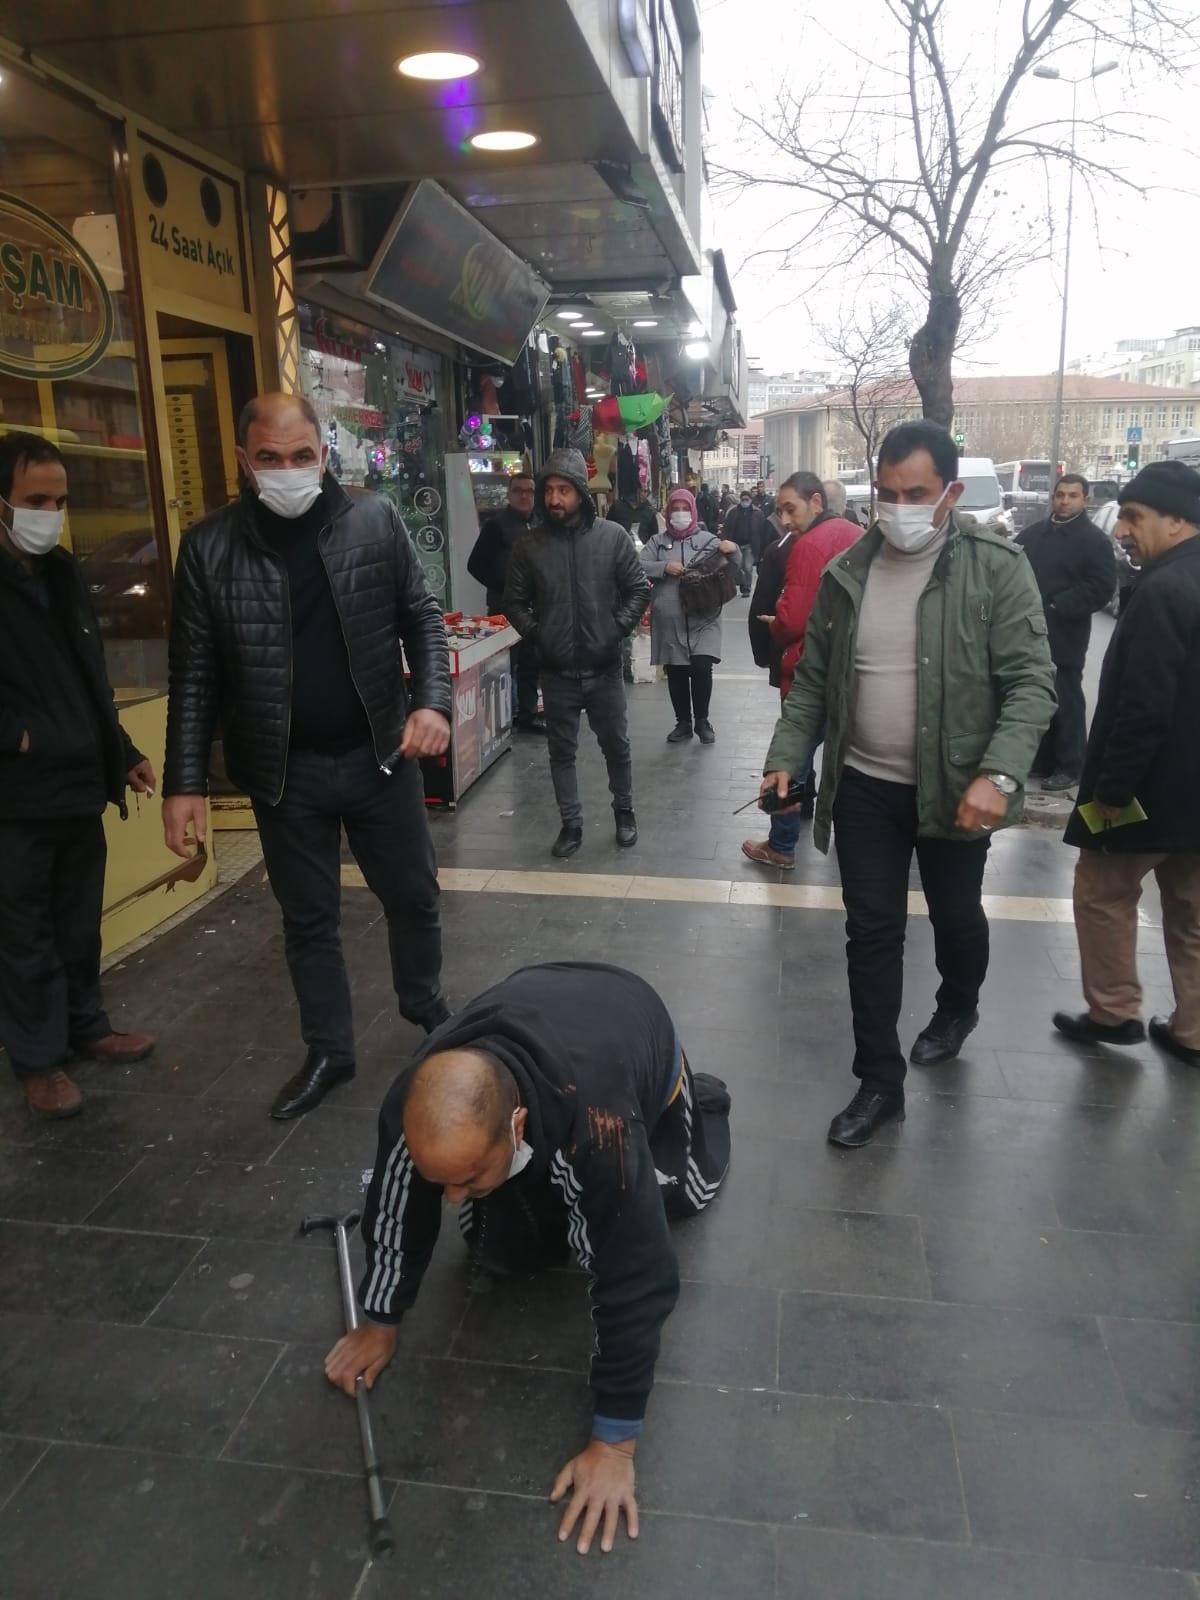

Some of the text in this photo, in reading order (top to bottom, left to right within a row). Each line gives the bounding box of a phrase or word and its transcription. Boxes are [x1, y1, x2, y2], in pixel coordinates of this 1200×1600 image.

[0, 242, 84, 311] ŞAM
[149, 213, 234, 275] 24 Saat Açık
